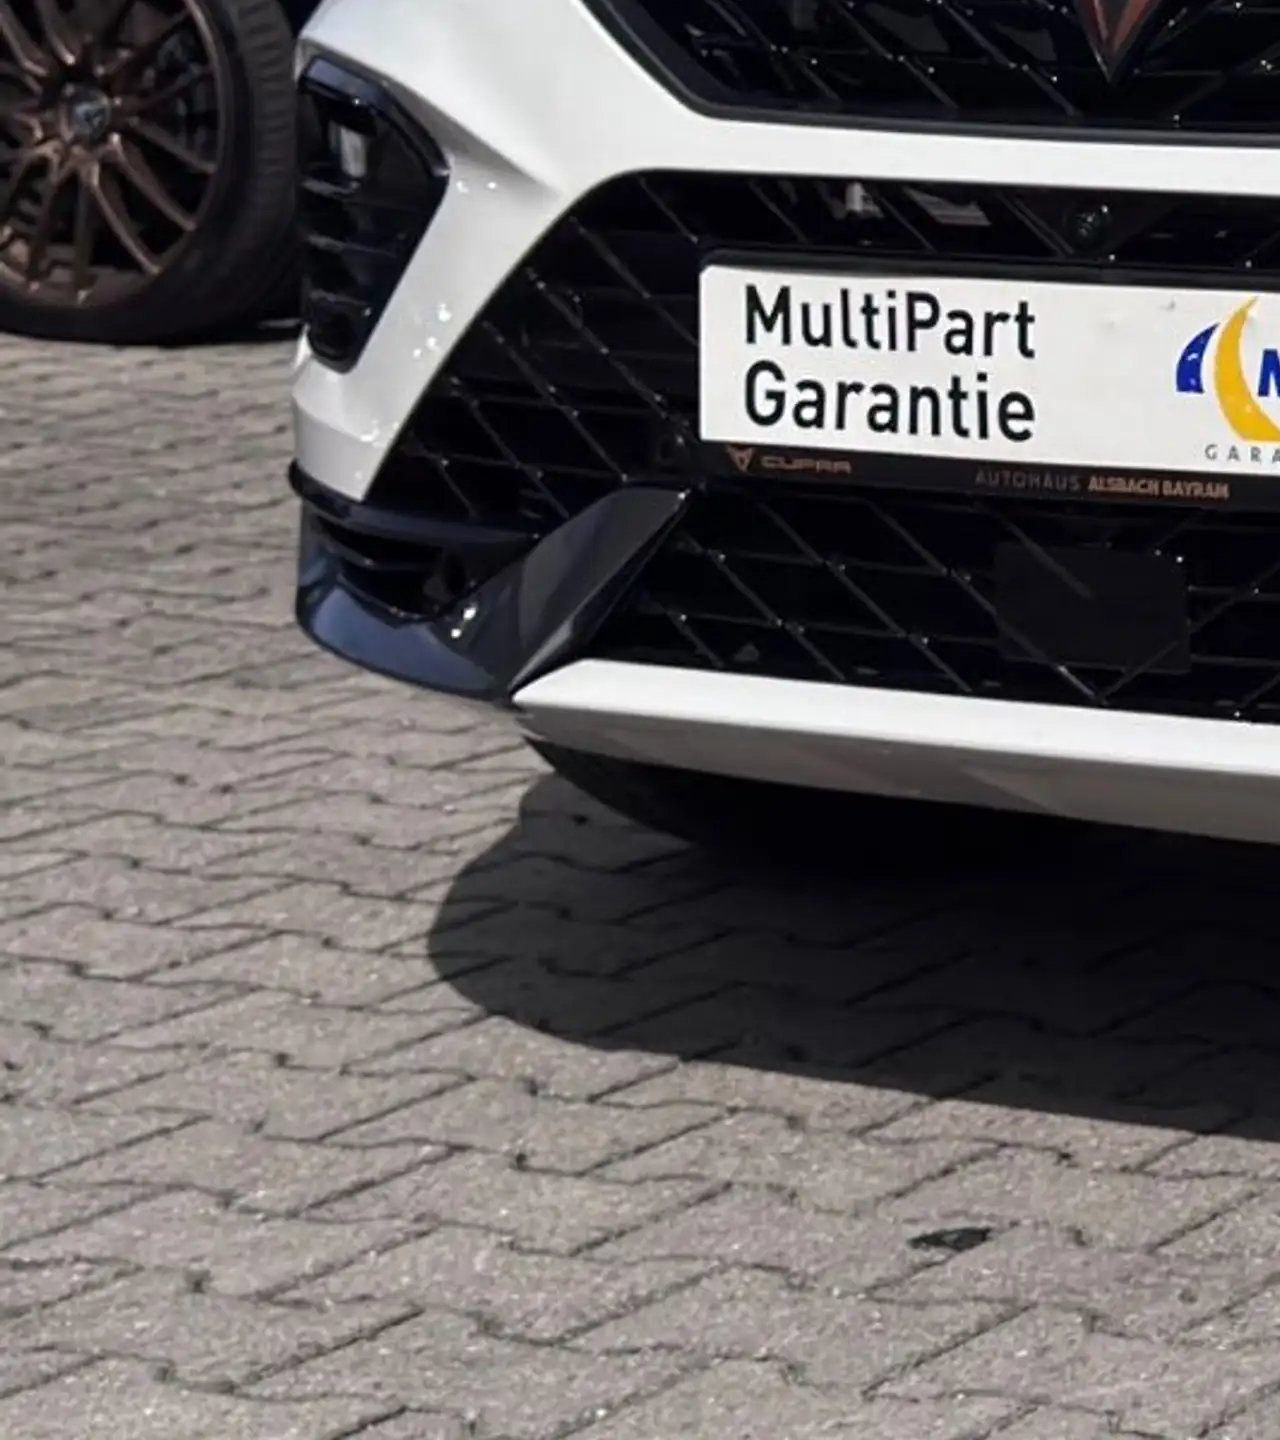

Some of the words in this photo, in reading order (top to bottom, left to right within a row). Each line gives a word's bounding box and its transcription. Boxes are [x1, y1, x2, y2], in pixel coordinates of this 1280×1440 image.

[745, 283, 1036, 359] MultiPart
[745, 360, 1036, 442] Garantie
[760, 455, 852, 473] CUPRA
[974, 469, 1081, 492] AUTOHAUS
[1087, 474, 1160, 496] ALSBACH
[1162, 479, 1230, 500] BAYRAM
